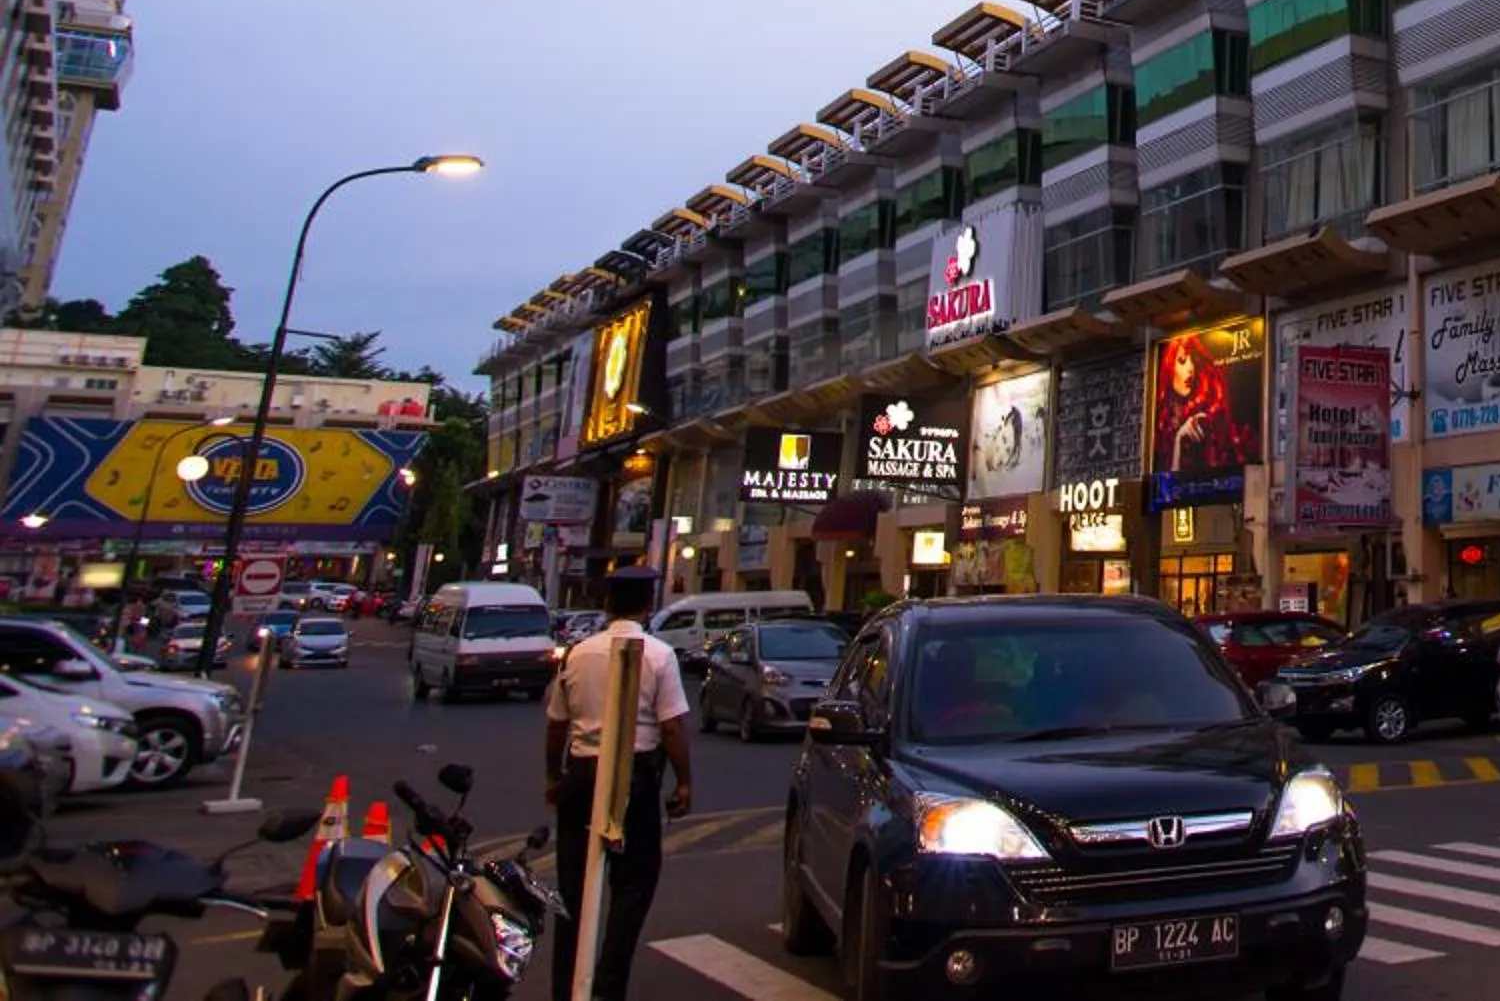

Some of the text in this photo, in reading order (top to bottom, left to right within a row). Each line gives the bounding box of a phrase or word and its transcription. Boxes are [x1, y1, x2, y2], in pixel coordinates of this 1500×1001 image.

[927, 279, 994, 331] SAKURA
[1430, 281, 1467, 306] FIVE
[1317, 309, 1348, 332] FIVE
[1353, 297, 1393, 325] STAR
[1231, 329, 1251, 356] JR
[1431, 309, 1495, 350] Family
[1304, 358, 1335, 380] FIVE
[1338, 362, 1375, 384] STAR
[1309, 403, 1356, 424] Hotel
[867, 436, 958, 464] SAKURA
[743, 470, 837, 490] MAJESTY
[867, 460, 957, 479] MASSAGE & SPA
[1060, 478, 1119, 512] HOOT
[1114, 916, 1234, 955] BP 1224 AC
